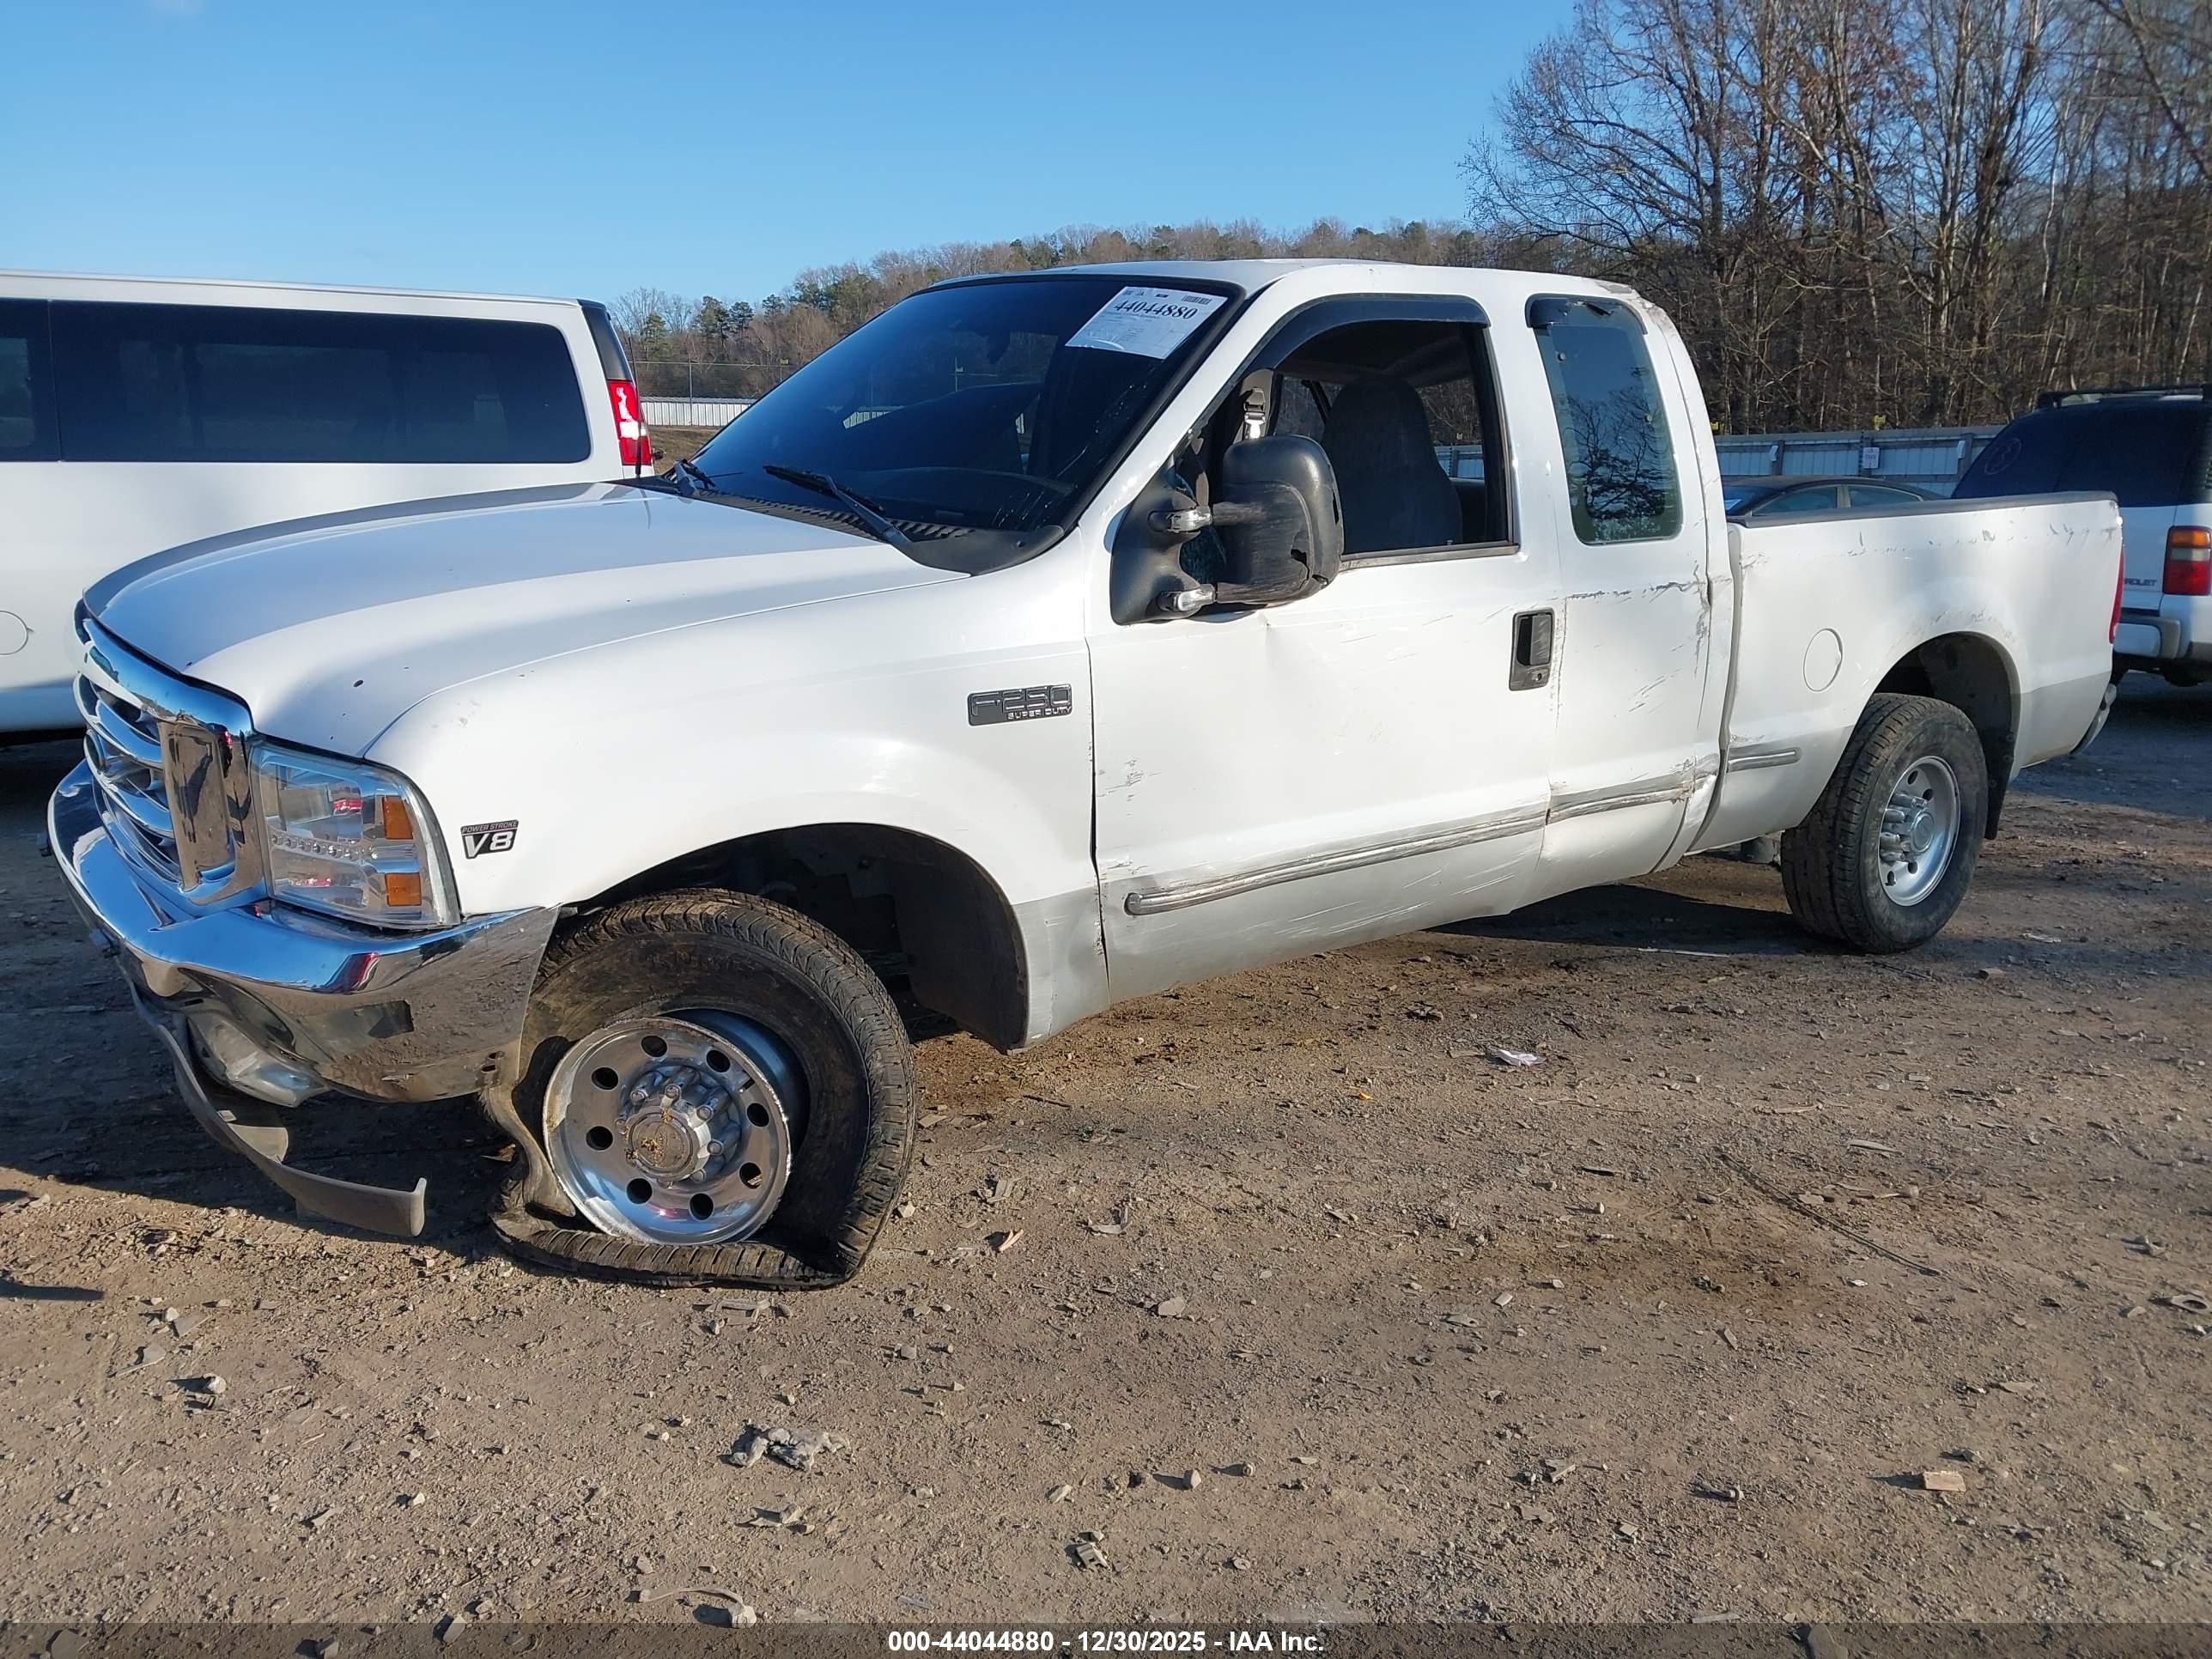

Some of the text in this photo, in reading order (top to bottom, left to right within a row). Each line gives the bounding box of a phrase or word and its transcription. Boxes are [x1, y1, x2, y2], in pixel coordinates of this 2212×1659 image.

[1114, 300, 1198, 319] 44044880
[2124, 578, 2158, 586] ROLET
[1008, 707, 1072, 720] SUPER DUTY
[490, 821, 517, 830] STROKE
[465, 831, 514, 857] V8
